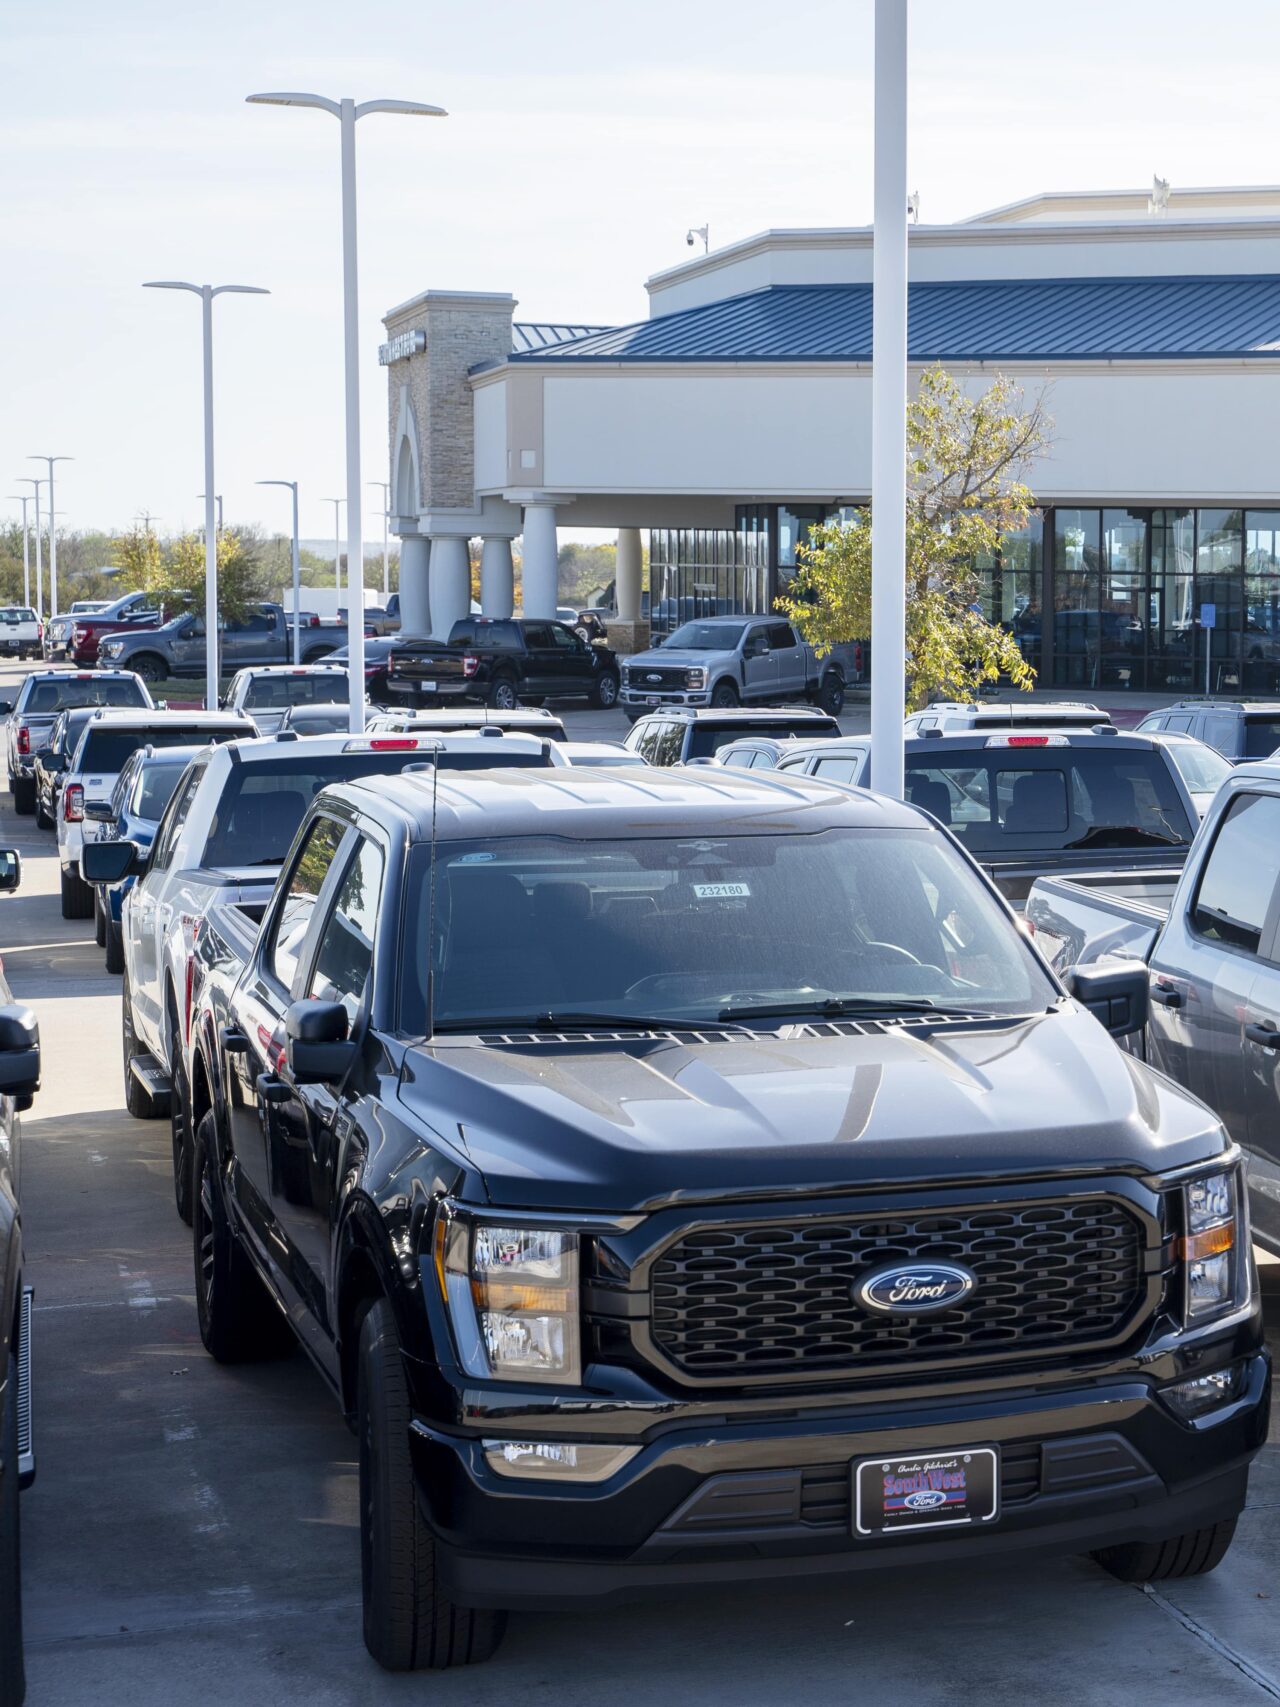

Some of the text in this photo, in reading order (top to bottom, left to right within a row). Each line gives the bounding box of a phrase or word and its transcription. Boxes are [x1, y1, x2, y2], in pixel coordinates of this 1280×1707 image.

[699, 885, 743, 896] 232180
[889, 1275, 947, 1302] Ford
[897, 1464, 922, 1473] Charlie
[913, 1493, 937, 1506] Ford
